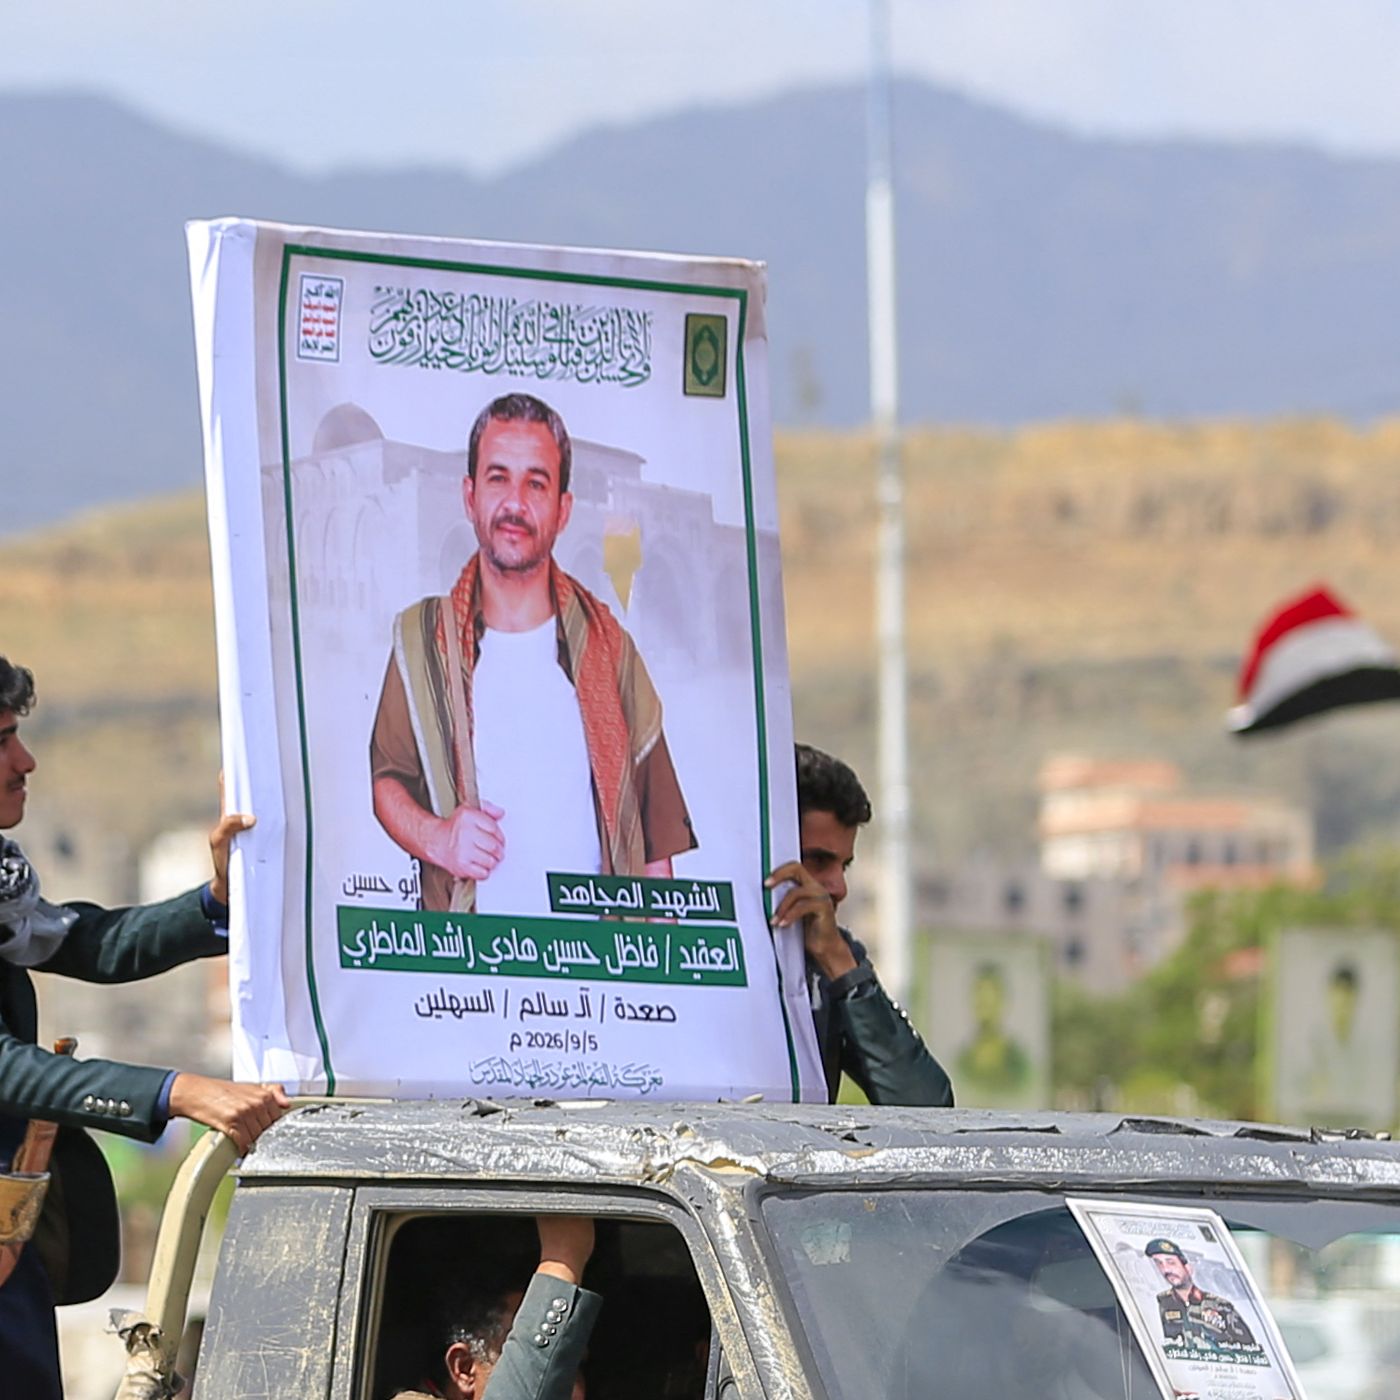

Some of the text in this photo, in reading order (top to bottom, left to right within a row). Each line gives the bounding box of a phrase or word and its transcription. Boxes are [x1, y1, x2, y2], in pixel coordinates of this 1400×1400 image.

[342, 864, 419, 900] أبو حسين
[559, 879, 720, 917] الشهيد المجاهد
[342, 920, 426, 967] الماطري
[432, 920, 475, 969] راشد
[478, 927, 539, 973] هادي
[543, 939, 600, 974] حسين
[679, 937, 740, 980] العقيد
[414, 986, 495, 1020] السهلين
[519, 991, 570, 1023] سالم
[614, 996, 677, 1023] صعدة
[510, 1032, 522, 1052] م
